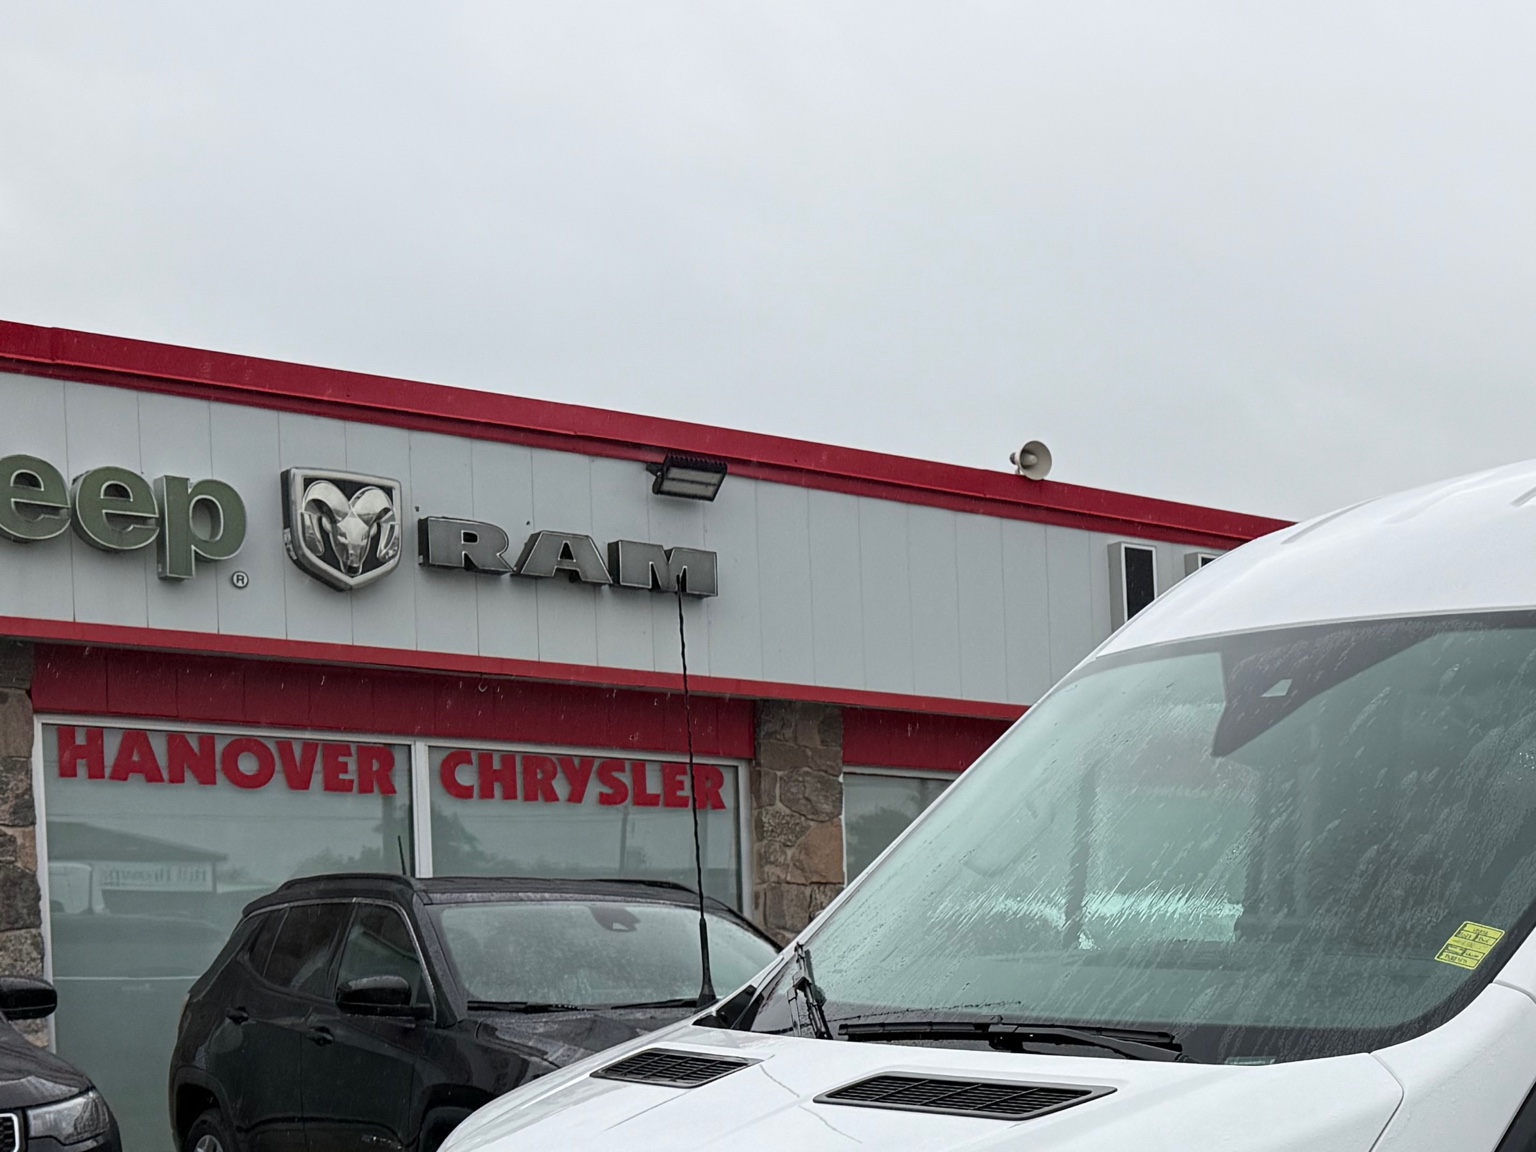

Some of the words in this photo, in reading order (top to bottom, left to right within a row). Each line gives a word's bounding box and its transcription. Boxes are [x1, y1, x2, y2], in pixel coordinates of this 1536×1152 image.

[0, 454, 247, 580] eep
[418, 516, 718, 598] RAM
[57, 726, 397, 795] HANOVER
[440, 750, 727, 810] CHRYSLER
